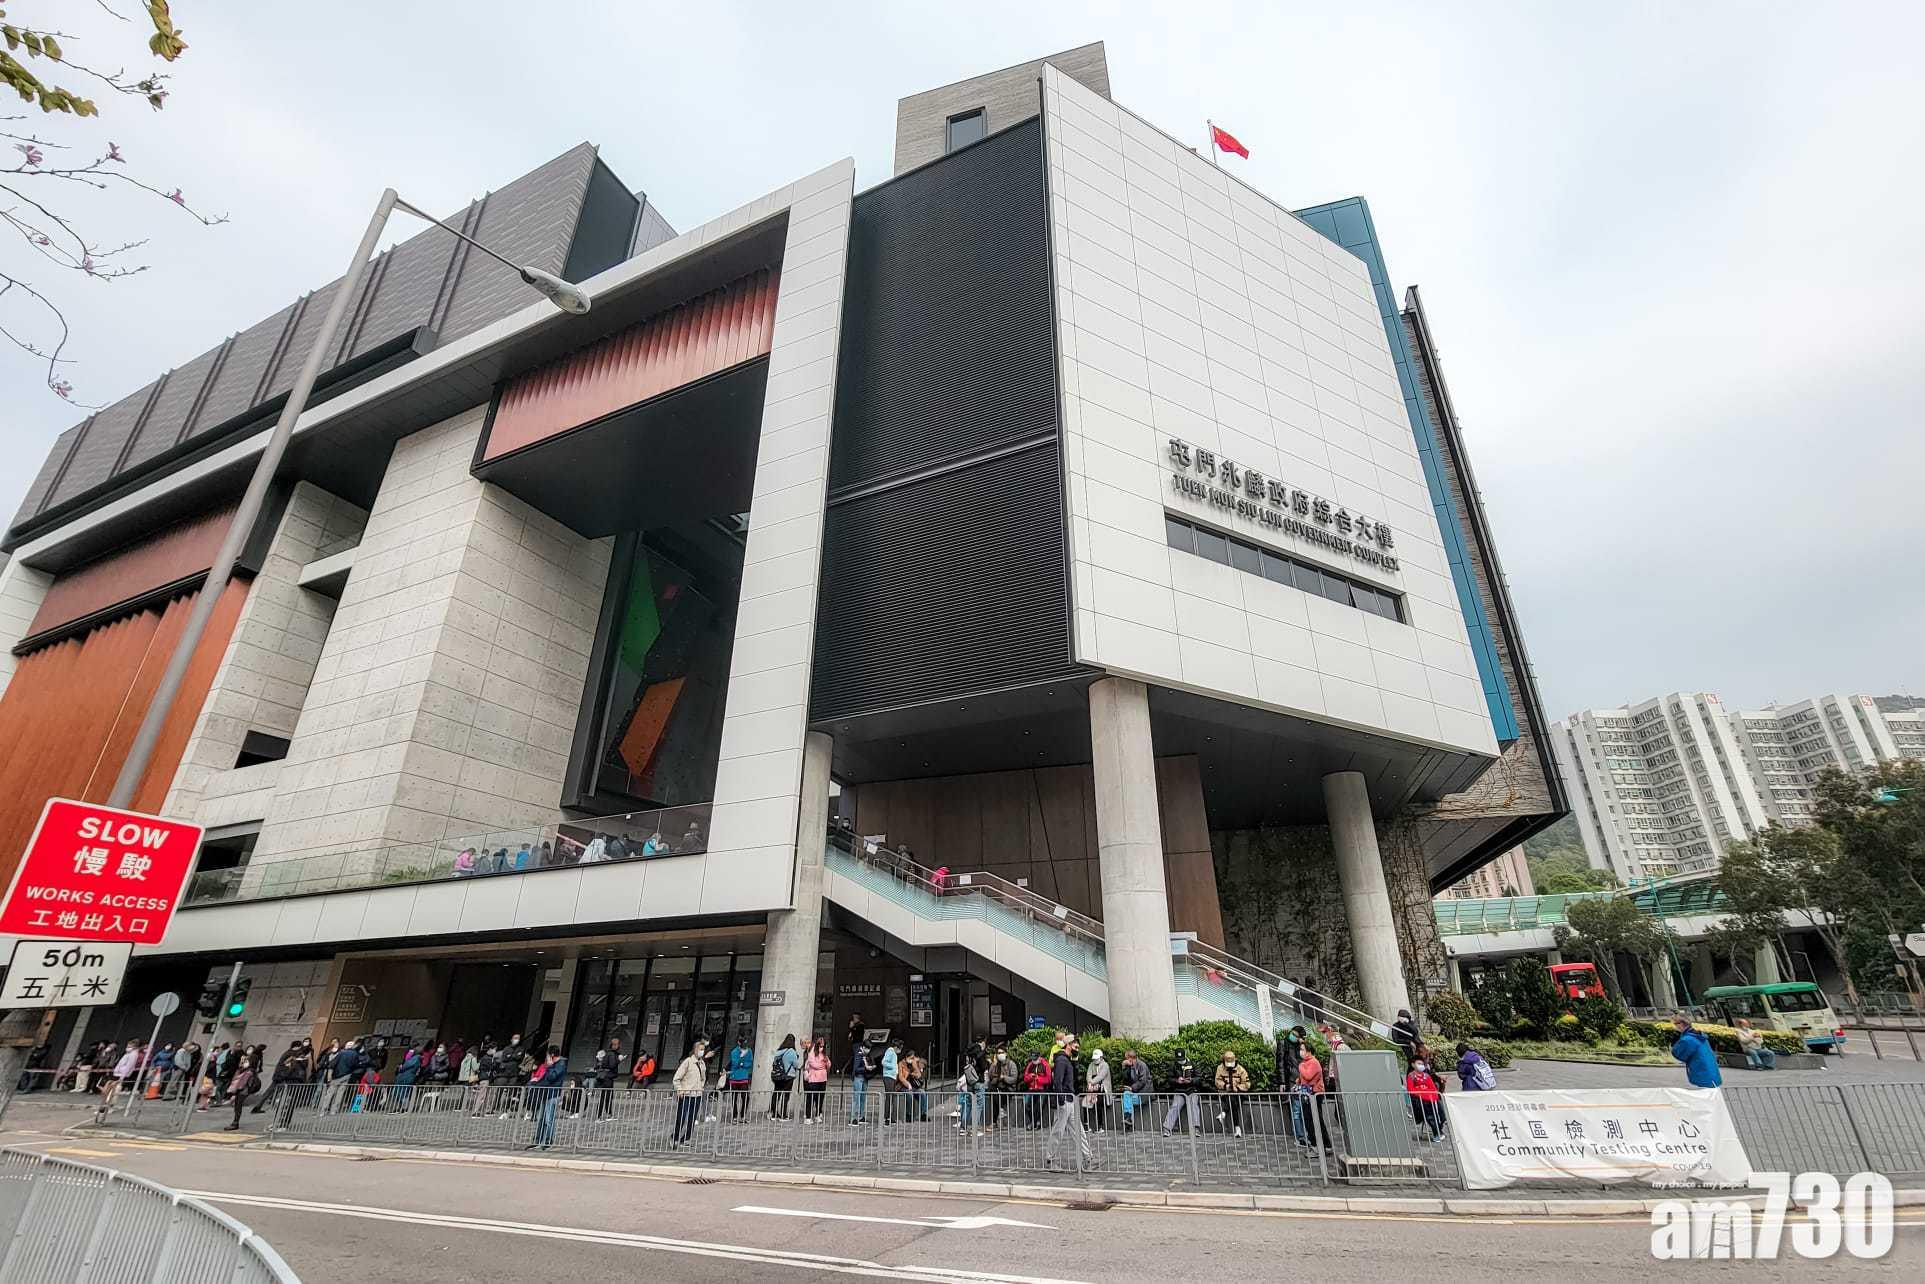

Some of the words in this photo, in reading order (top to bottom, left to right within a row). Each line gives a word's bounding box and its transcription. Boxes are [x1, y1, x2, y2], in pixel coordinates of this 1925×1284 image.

[1168, 438, 1395, 549] 屯門兆麟政府綜合大樓
[1173, 474, 1206, 499] TUEN
[1208, 487, 1236, 510] MUN
[1237, 498, 1258, 518] SIU
[1259, 507, 1282, 529] LUN
[1283, 517, 1354, 555] GOVERNMENT
[1354, 544, 1400, 572] COMPLEX
[77, 816, 170, 849] SLOW
[73, 845, 152, 881] 慢駛
[26, 885, 95, 904] WORKS
[99, 893, 168, 911] ACCESS
[27, 909, 149, 934] 工地出入口
[42, 949, 105, 967] 50m
[16, 975, 109, 999] 五十米
[1490, 1119, 1701, 1141] 社區檢測中心
[1496, 1142, 1586, 1159] Community
[1591, 1143, 1651, 1157] Testing
[1655, 1141, 1709, 1155] Centre
